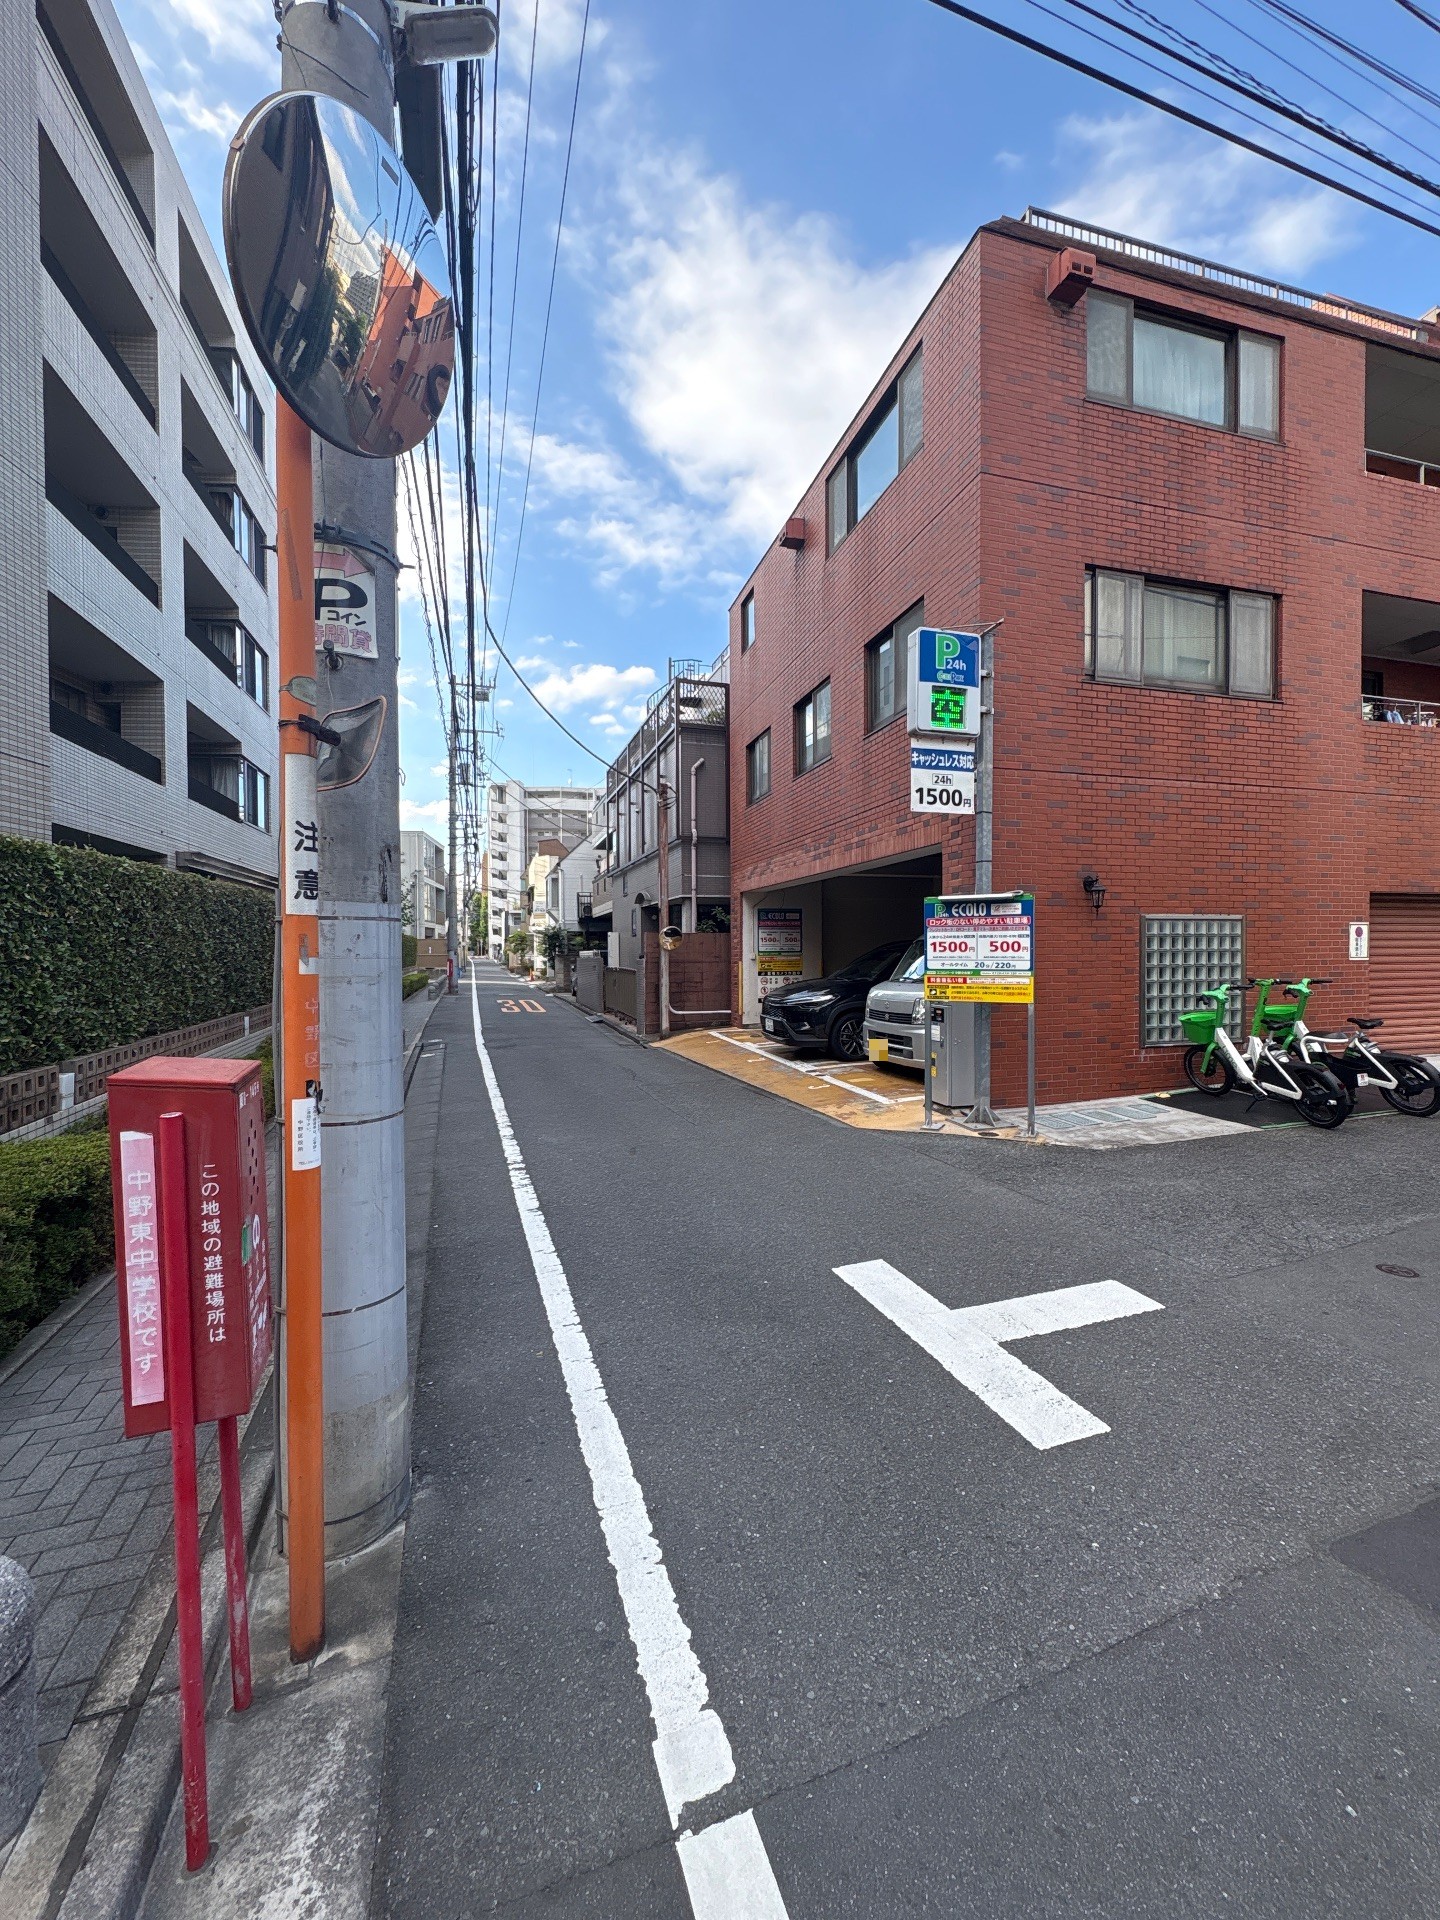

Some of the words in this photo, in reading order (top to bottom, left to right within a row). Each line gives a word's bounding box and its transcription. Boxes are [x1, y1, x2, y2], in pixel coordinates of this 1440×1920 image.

[315, 578, 368, 620] P
[327, 609, 367, 626] コイン
[935, 634, 961, 669] P
[946, 658, 967, 671] 24h
[931, 689, 965, 729] 空
[911, 751, 974, 769] キャッシュレス対応
[933, 775, 952, 785] 24h
[915, 787, 972, 807] 1500円
[952, 903, 986, 917] ECOLO
[930, 941, 976, 953] 1500円
[989, 940, 1029, 953] 500円
[496, 999, 547, 1013] 30
[200, 1163, 226, 1342] この地域の避難場所は
[127, 1169, 159, 1374] 中野東中学校です
